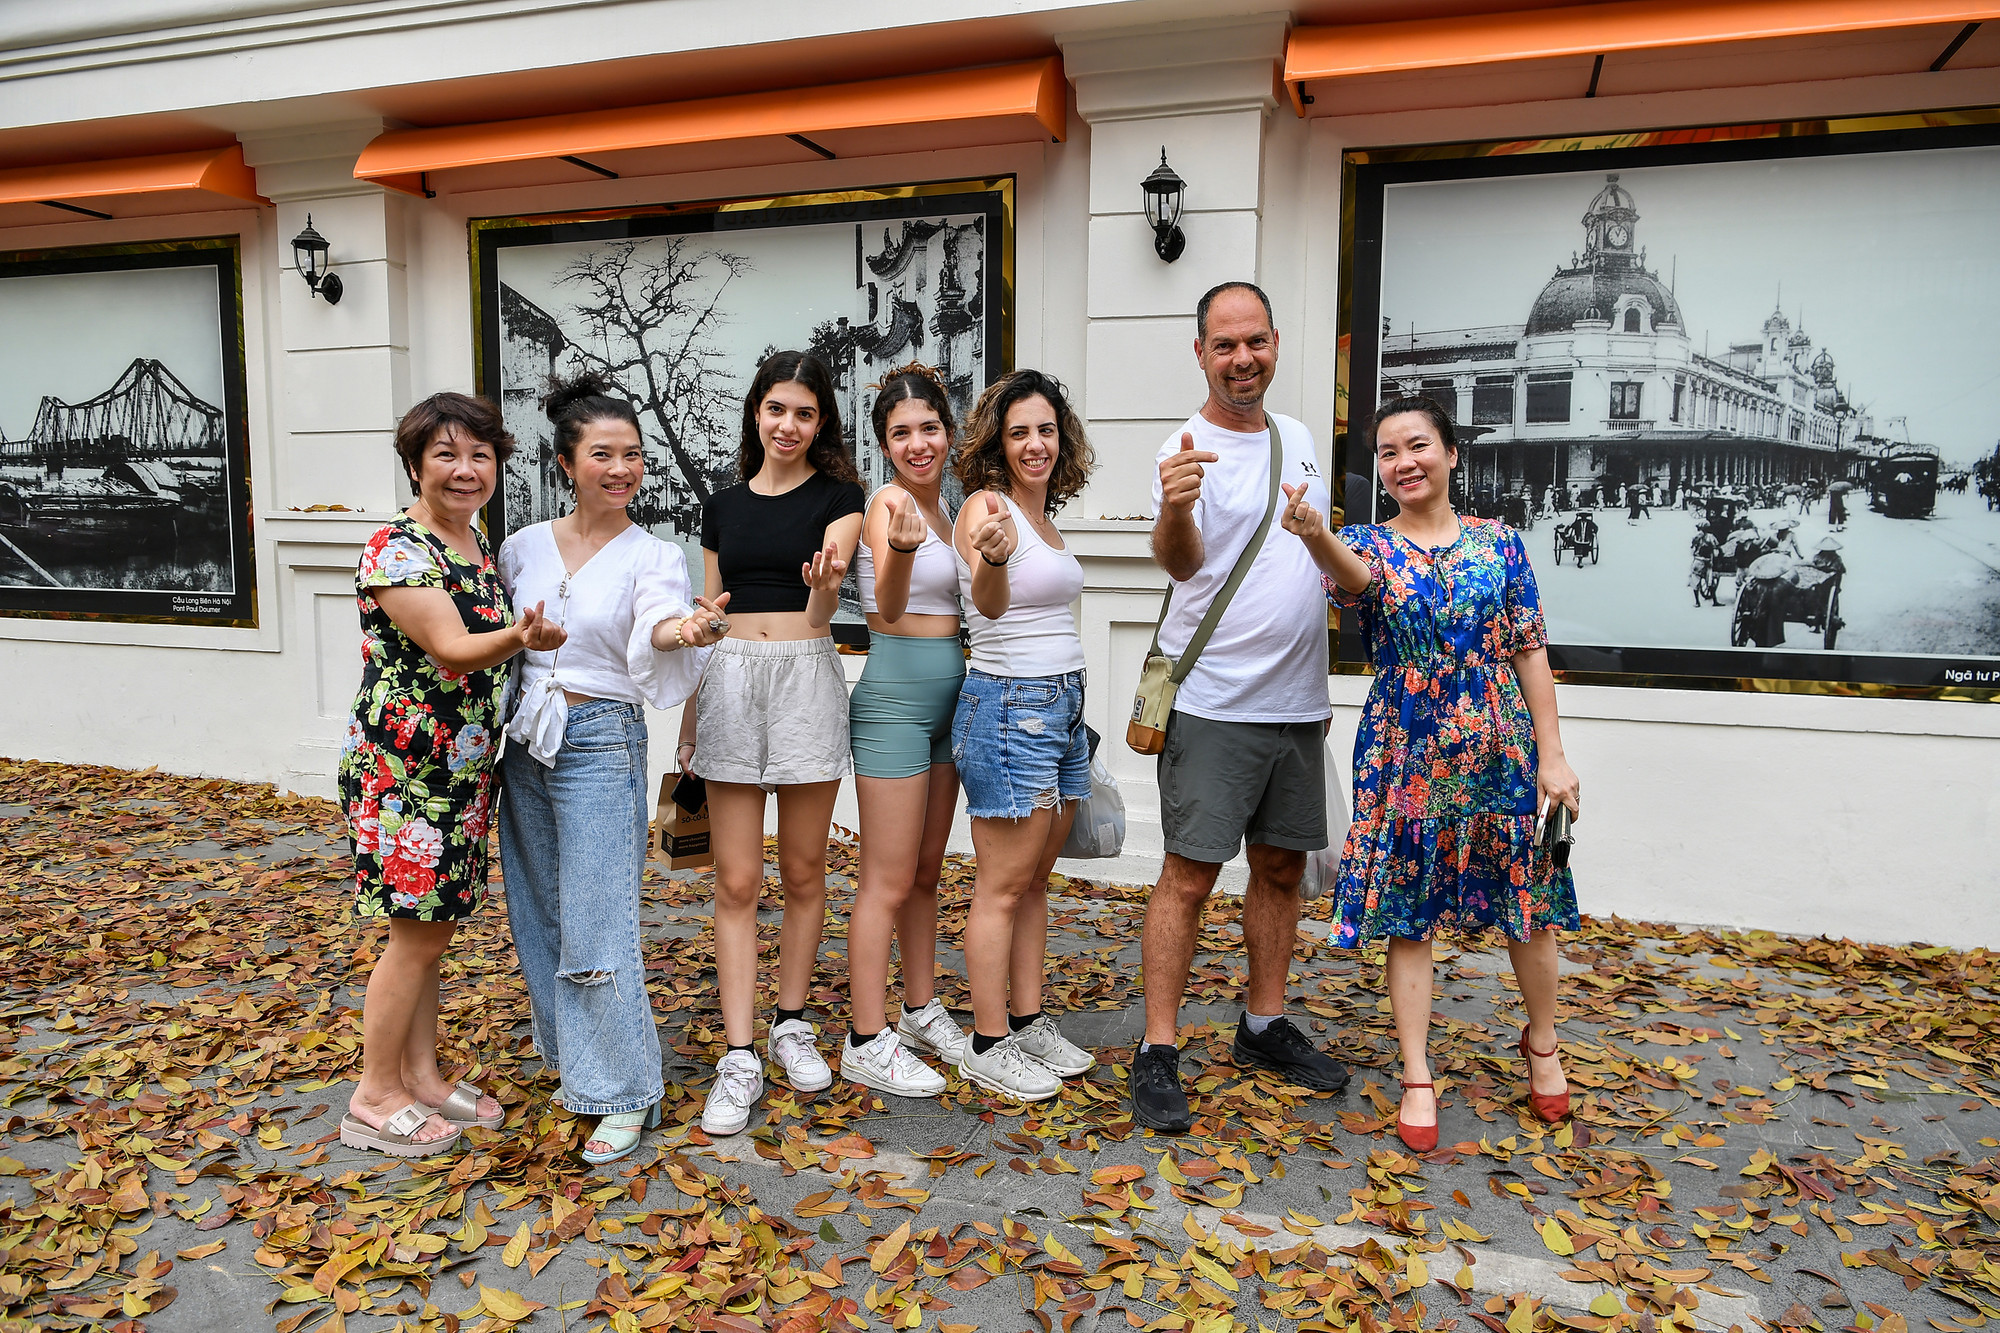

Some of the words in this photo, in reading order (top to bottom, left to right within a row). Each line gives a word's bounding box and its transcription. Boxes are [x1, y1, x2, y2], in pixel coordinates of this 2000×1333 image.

[186, 597, 199, 605] Long
[1945, 669, 1973, 682] Ngã
[1976, 670, 1990, 681] tư
